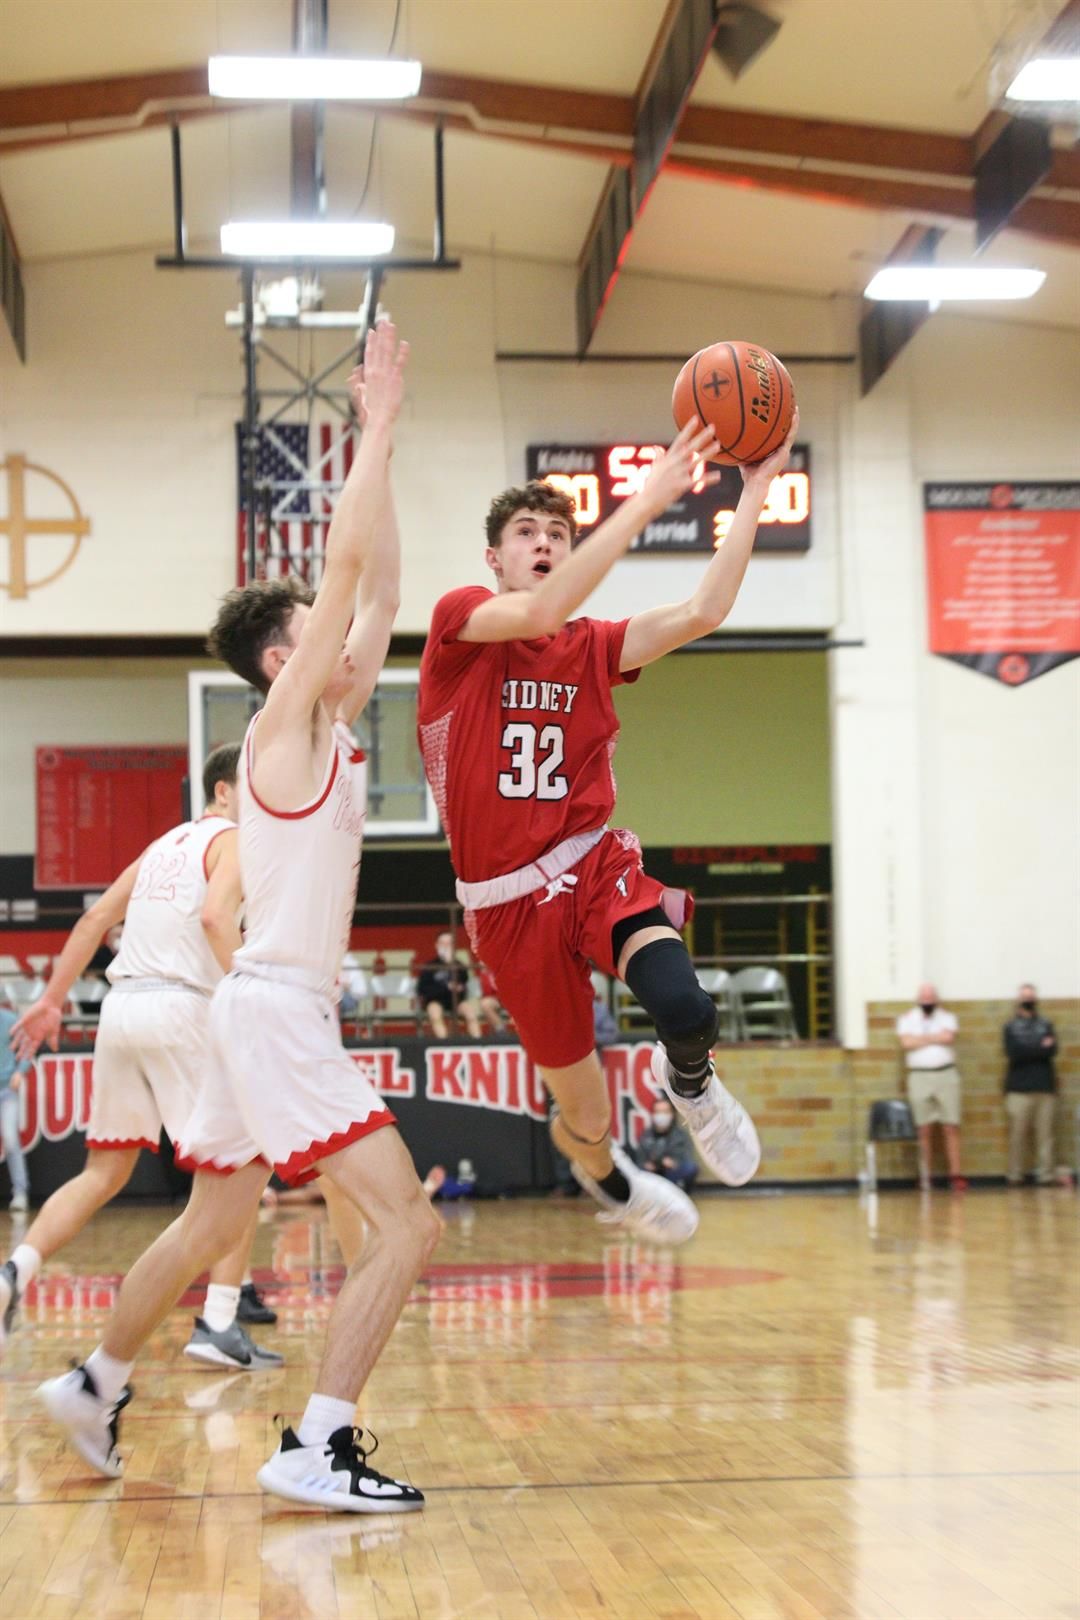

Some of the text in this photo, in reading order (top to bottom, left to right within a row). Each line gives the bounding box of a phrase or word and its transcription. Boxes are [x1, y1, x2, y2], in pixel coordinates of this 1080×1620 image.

[644, 520, 699, 547] period
[501, 679, 579, 713] SIDNEY
[498, 722, 570, 801] 32
